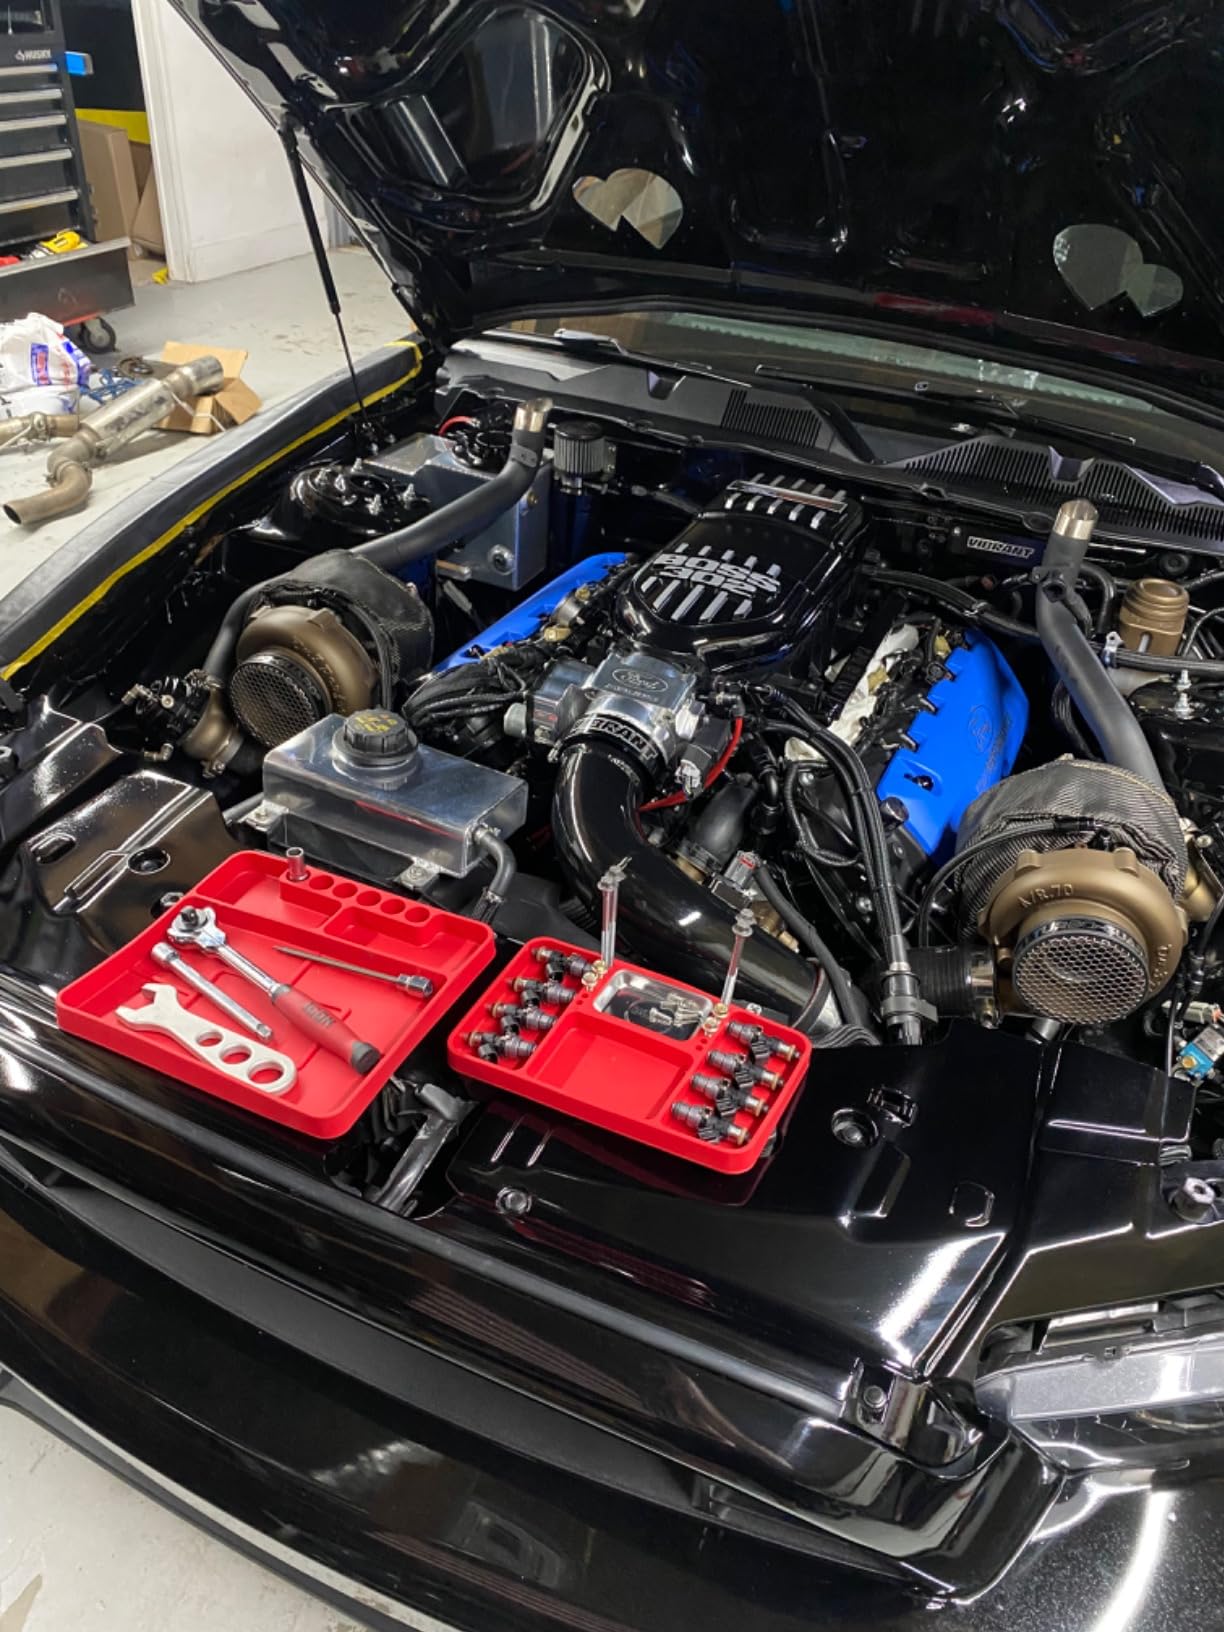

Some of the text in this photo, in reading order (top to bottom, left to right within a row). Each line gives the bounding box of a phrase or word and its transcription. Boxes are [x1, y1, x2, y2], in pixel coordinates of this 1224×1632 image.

[966, 535, 1034, 559] VIBRANT
[653, 553, 781, 592] BOSS
[659, 565, 757, 599] 302
[618, 671, 661, 690] Ford
